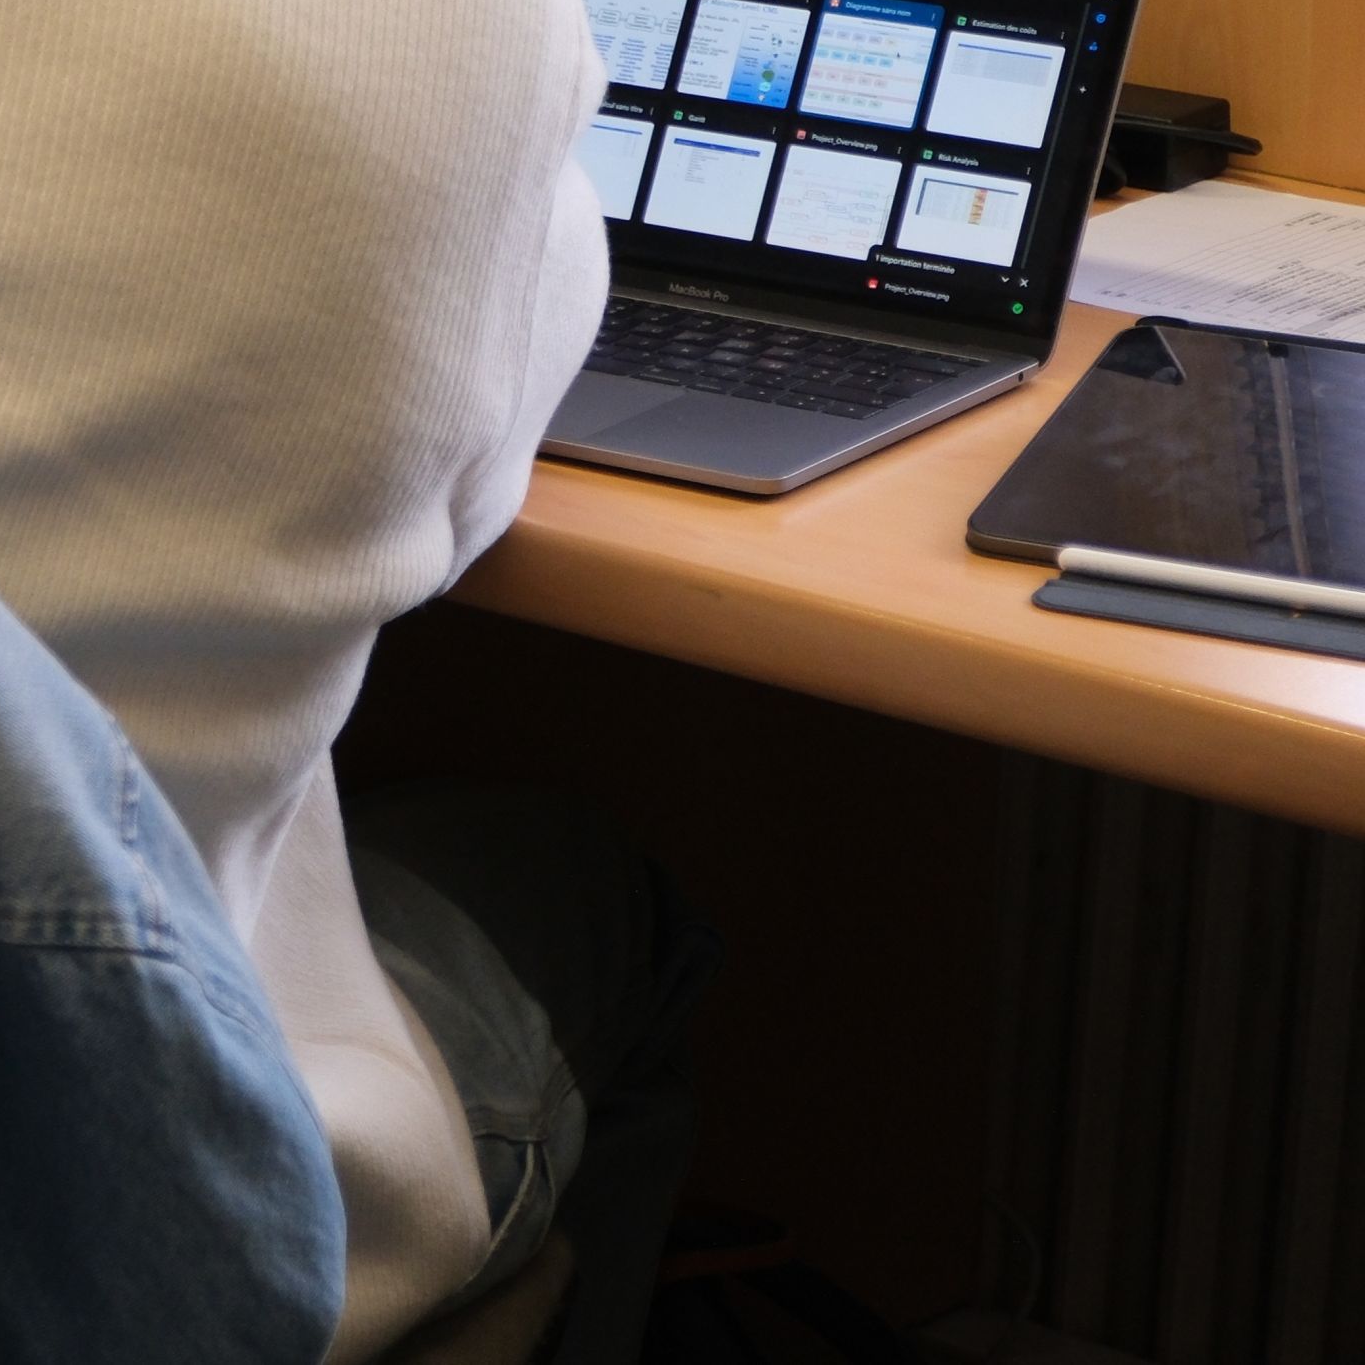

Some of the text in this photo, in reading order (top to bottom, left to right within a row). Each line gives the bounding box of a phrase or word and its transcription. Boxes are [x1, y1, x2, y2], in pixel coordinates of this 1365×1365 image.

[845, 1, 912, 17] Diagramme sans nom
[972, 19, 1038, 35] Estimation des coûts
[811, 133, 879, 152] Project_Overview.png
[938, 153, 979, 167] Risk Analysis
[879, 254, 922, 270] importation
[922, 261, 955, 275] terminée
[669, 283, 730, 302] MacBook Pro
[884, 282, 950, 303] Project_Overview.png
